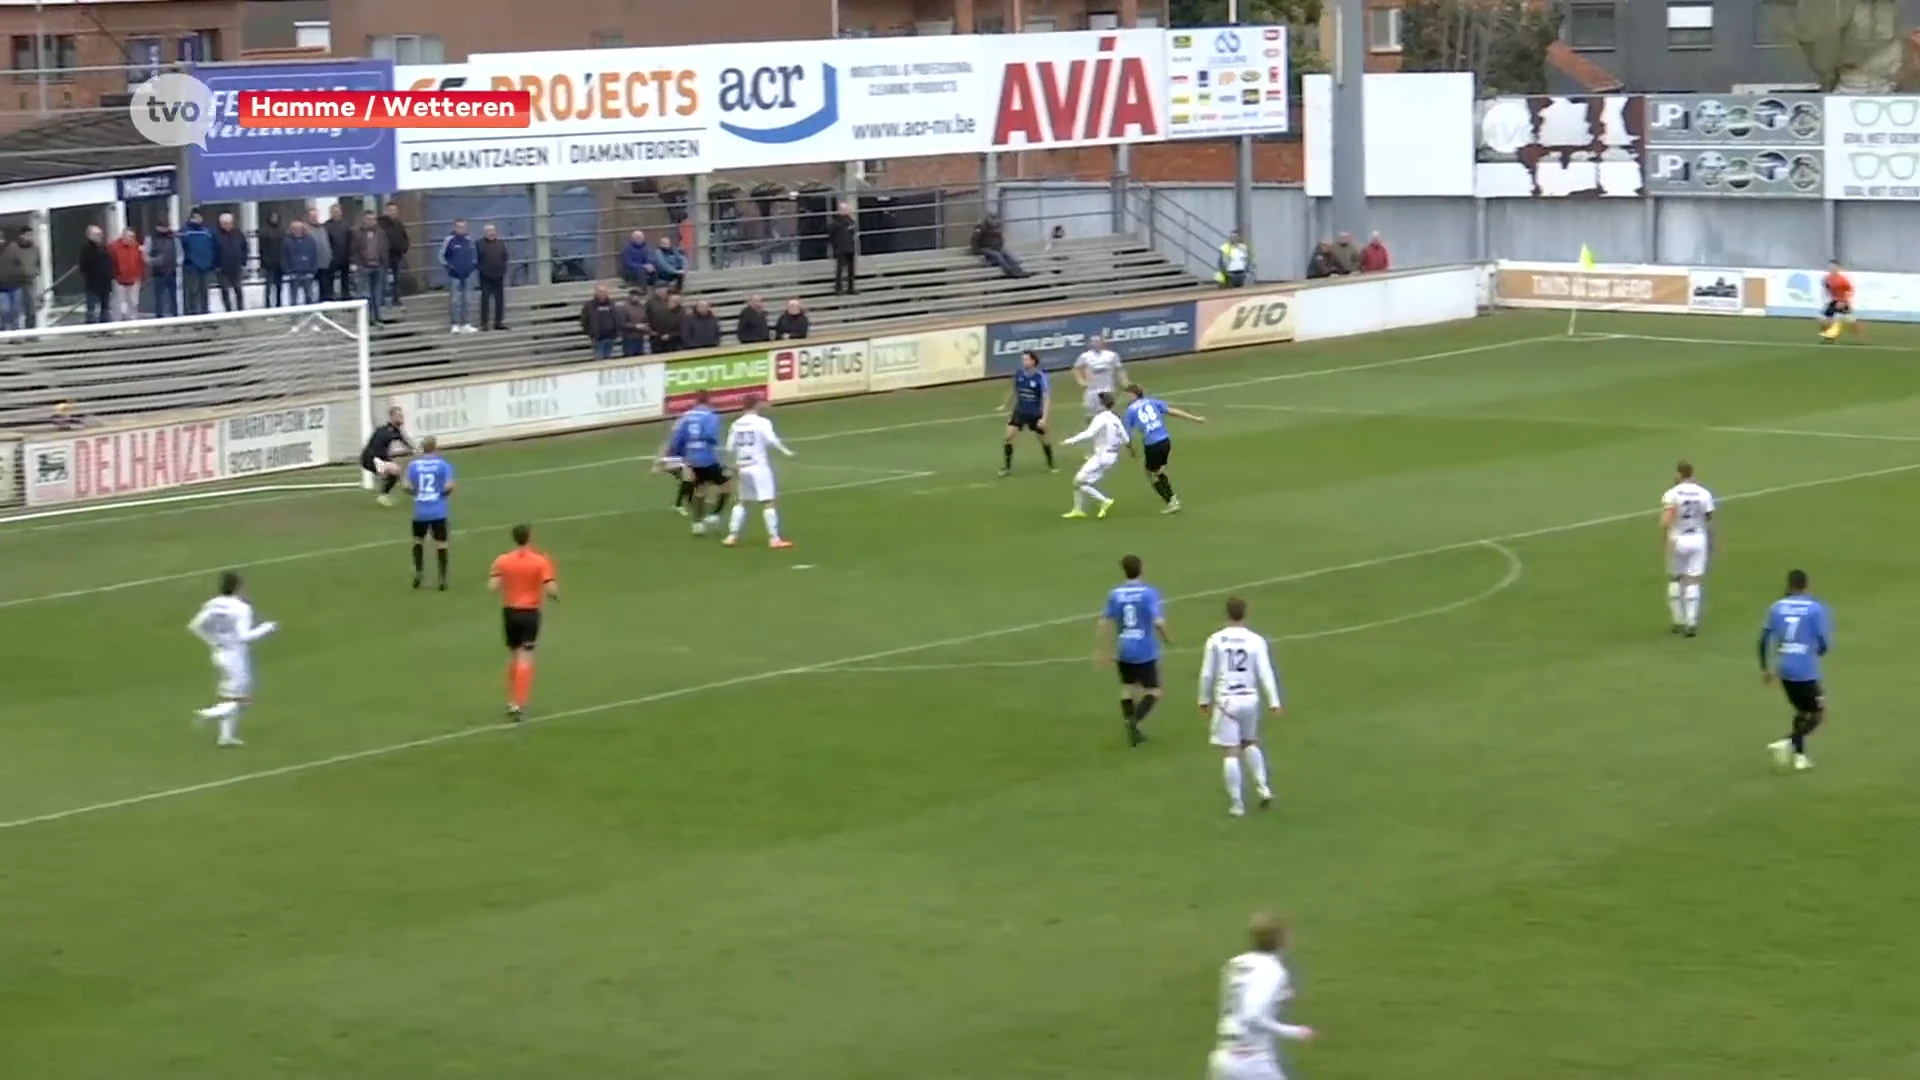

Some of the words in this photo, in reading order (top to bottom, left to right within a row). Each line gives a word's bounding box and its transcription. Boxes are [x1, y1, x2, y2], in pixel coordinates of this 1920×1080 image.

[718, 64, 804, 112] acr
[993, 36, 1158, 146] AVIA
[410, 146, 549, 173] DIAMANTZAGEN
[569, 139, 700, 164] DIAMANTBOREN
[212, 158, 376, 188] www.federale.be
[994, 333, 1086, 356] Lemeire
[1102, 320, 1189, 342] Lemeire
[665, 357, 769, 388] FOOTLINE
[799, 345, 864, 379] Belfius
[1137, 404, 1158, 424] 68
[75, 420, 216, 497] DELHAIZE
[418, 472, 436, 493] 12
[1783, 616, 1801, 641] 7
[1224, 647, 1249, 673] 12
